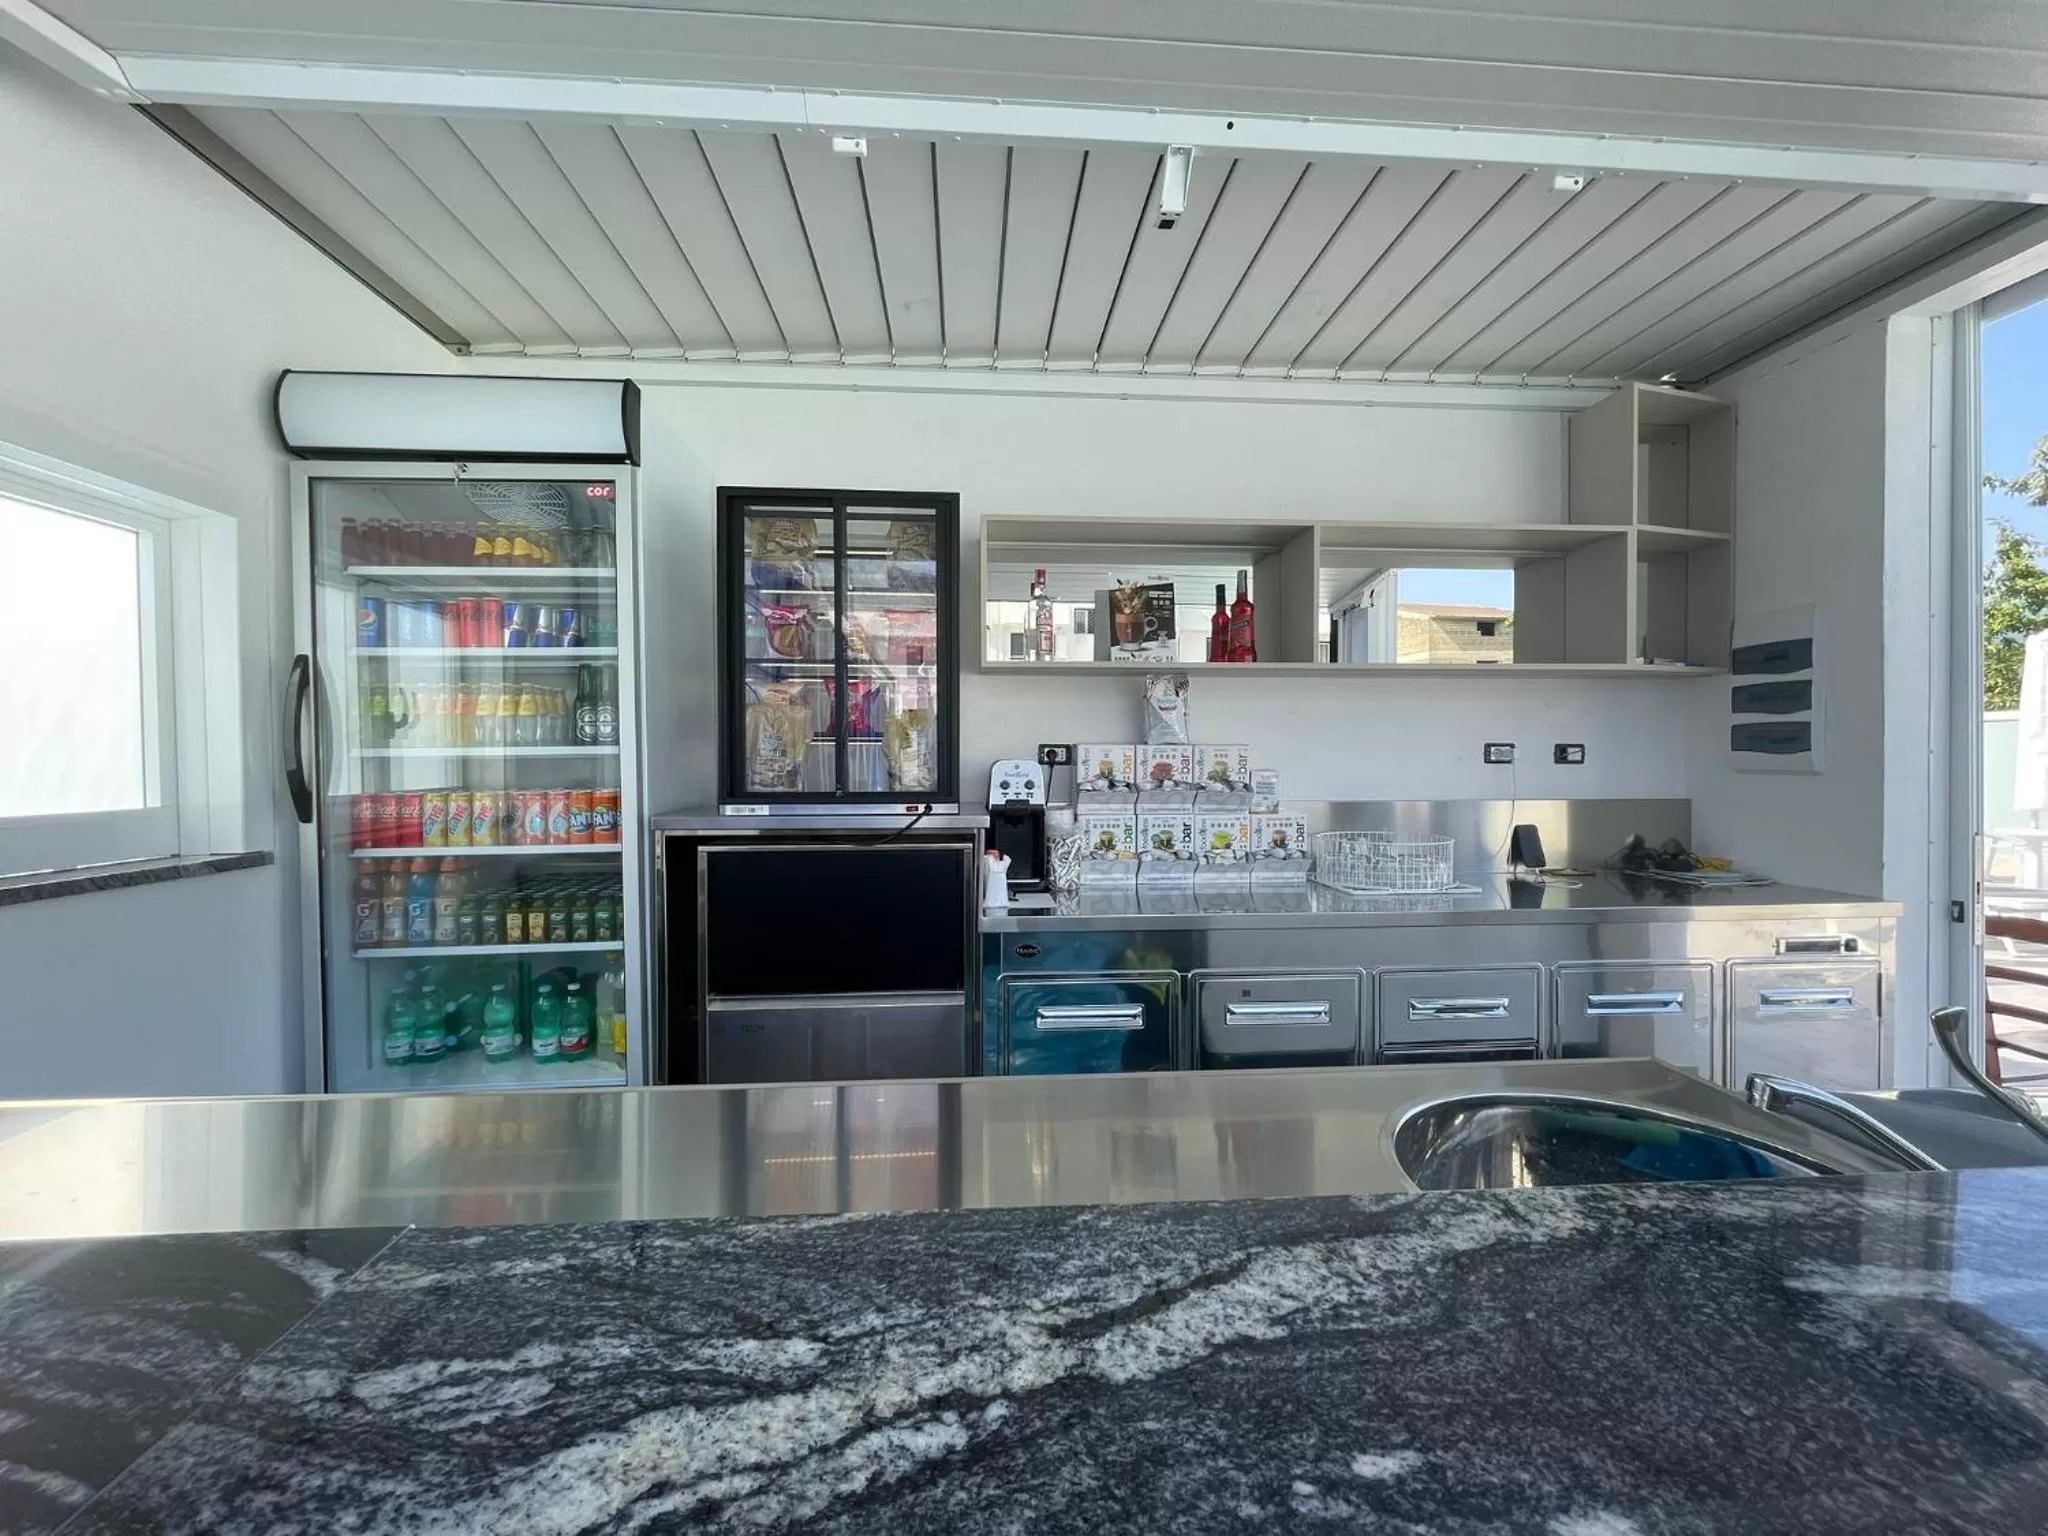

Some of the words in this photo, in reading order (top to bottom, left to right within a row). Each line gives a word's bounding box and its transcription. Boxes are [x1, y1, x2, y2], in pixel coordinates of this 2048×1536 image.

[1181, 753, 1190, 775] bar
[1236, 753, 1248, 775] bar
[1122, 822, 1133, 844] bar
[1180, 822, 1192, 844] bar
[1239, 822, 1248, 844] bar
[1295, 822, 1305, 843] bar
